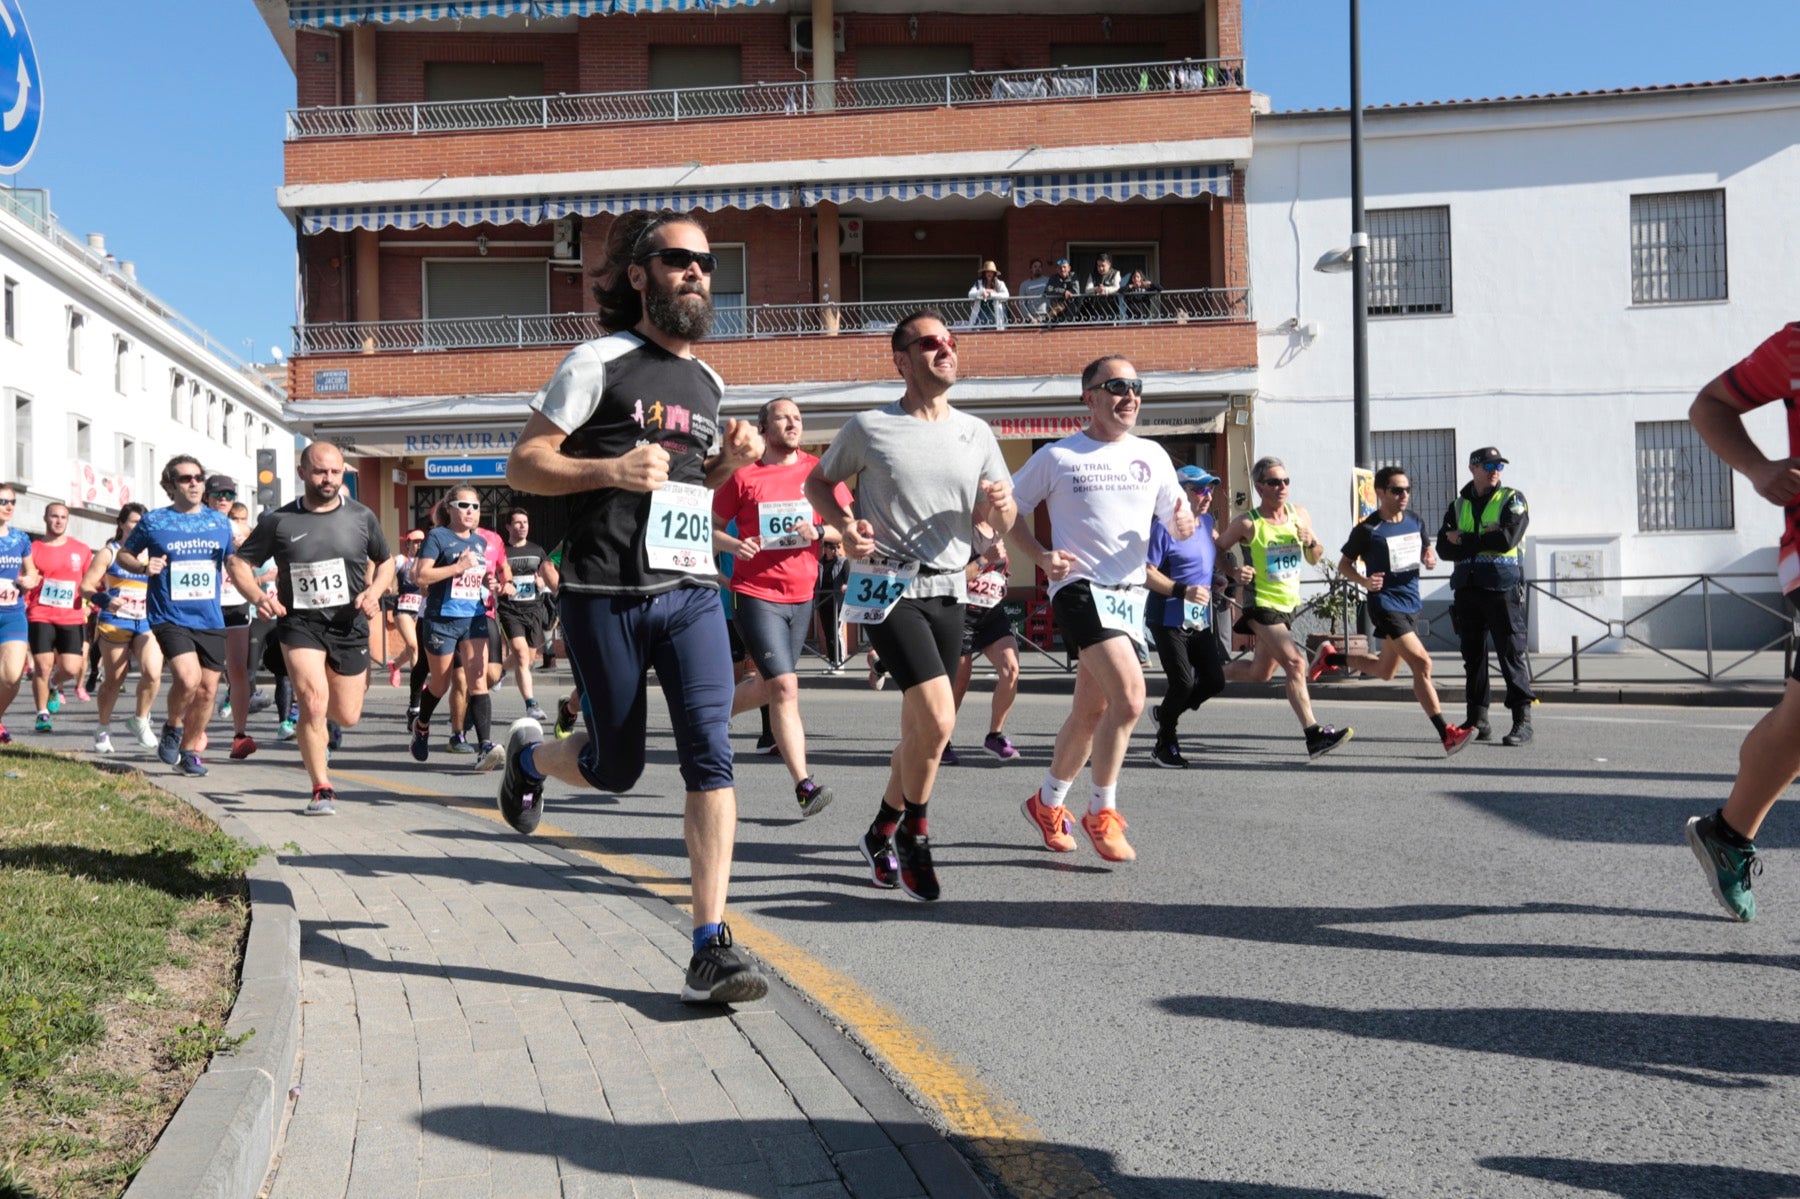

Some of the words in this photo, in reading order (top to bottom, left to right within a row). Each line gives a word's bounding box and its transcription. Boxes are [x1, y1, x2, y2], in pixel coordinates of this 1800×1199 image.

[1153, 417, 1183, 426] CERVEZAS
[428, 463, 473, 473] Granada
[1072, 464, 1081, 472] IV
[1084, 463, 1112, 471] TRAIL
[1072, 474, 1127, 484] NOCTURNO
[1073, 485, 1104, 493] DEHESA
[661, 510, 710, 543] 1205
[167, 538, 220, 553] agustinos
[1274, 555, 1297, 570] 160
[180, 573, 210, 587] 489
[299, 574, 342, 592] 3113
[455, 575, 481, 588] 2096
[45, 586, 73, 599] 1129
[1106, 595, 1133, 624] 341
